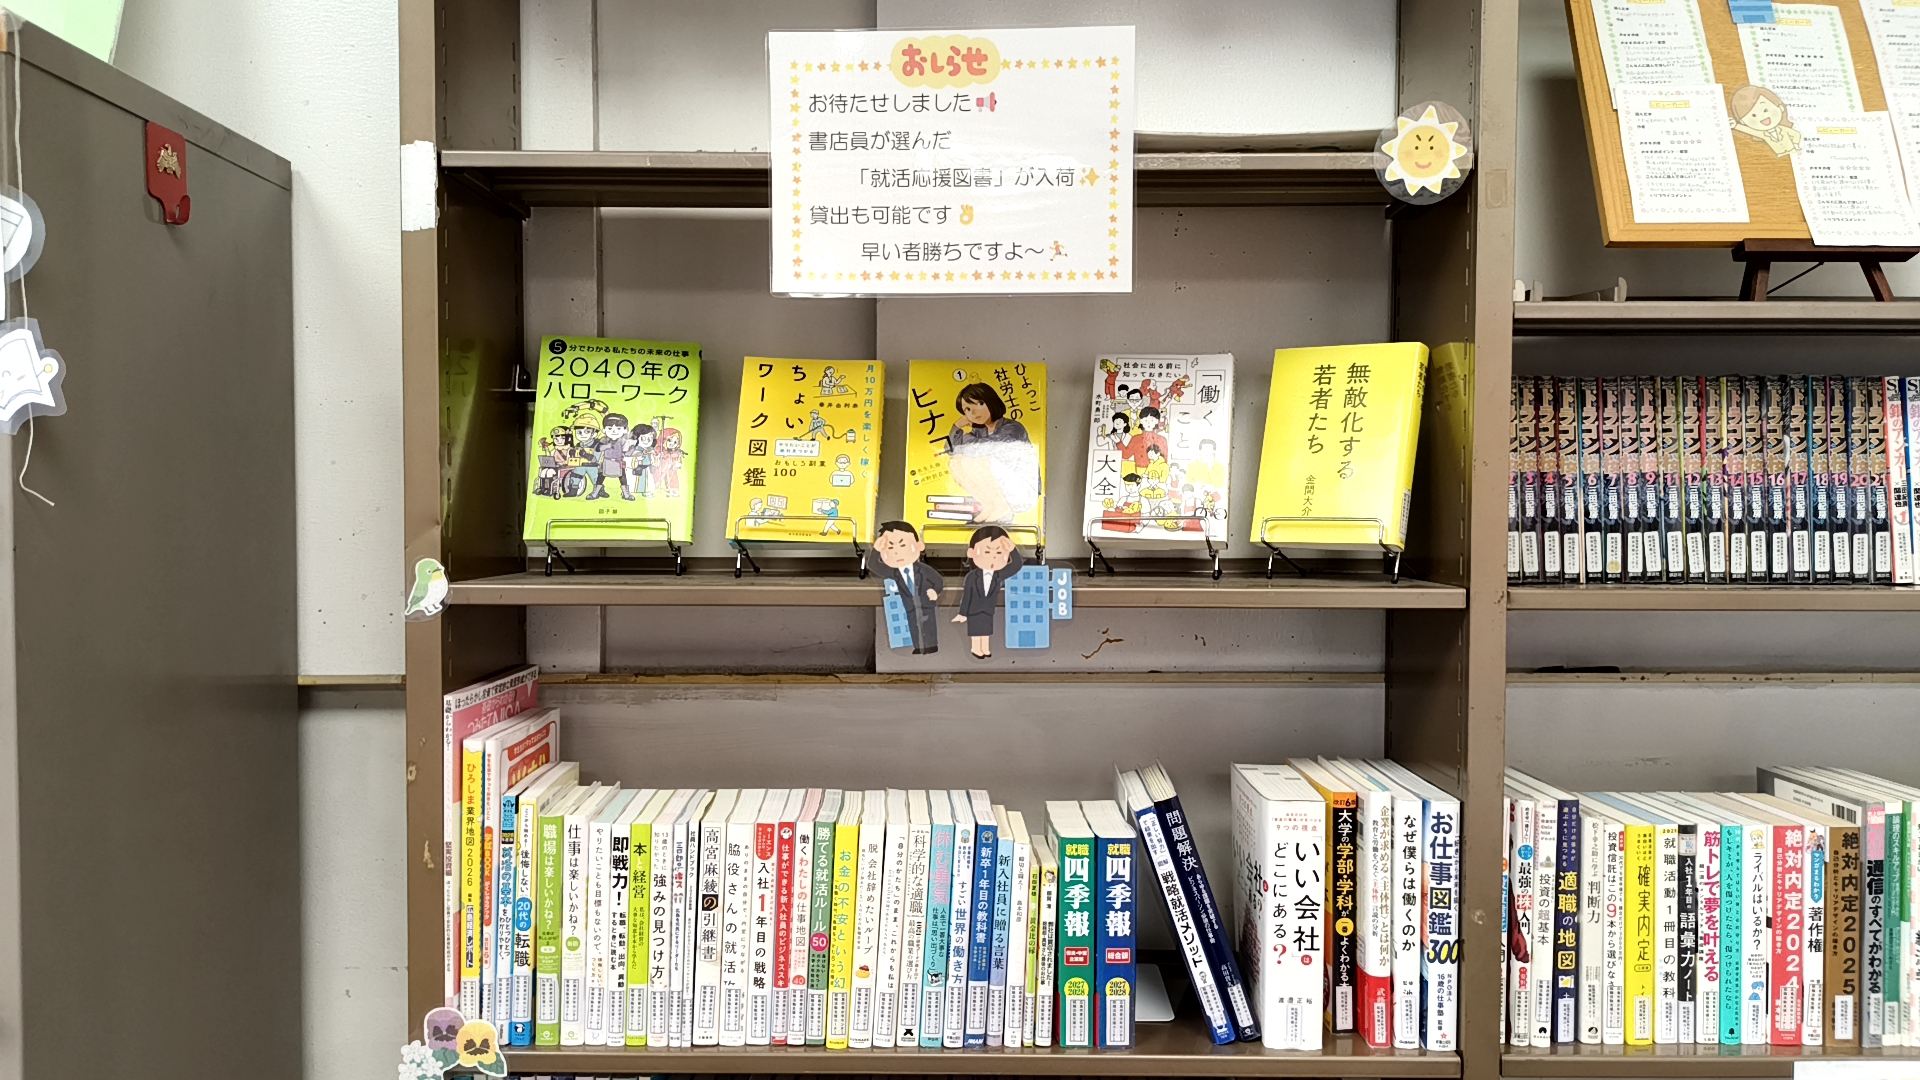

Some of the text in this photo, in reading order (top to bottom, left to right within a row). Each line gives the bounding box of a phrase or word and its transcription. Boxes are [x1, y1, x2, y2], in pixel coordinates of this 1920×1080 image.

[902, 44, 988, 76] おしらせ
[808, 93, 972, 113] お待たせしました
[808, 131, 951, 150] 書店員が選んだ
[858, 168, 1075, 188] 「就活応援図書」が入荷
[809, 206, 952, 225] 貸出も可能です
[543, 381, 688, 404] ハローワーク
[548, 356, 690, 381] 2040年の
[785, 364, 806, 429] ちょい
[994, 367, 1023, 420] 社労士の
[1123, 362, 1182, 370] 社会に出る前に
[742, 363, 773, 486] ワーク図鑑
[860, 364, 876, 478] 月10万円を楽しく稼ぐ
[1197, 374, 1222, 427] 「働く
[1307, 364, 1336, 454] 若者たち
[1337, 362, 1372, 479] 無敵化する
[773, 468, 797, 477] 100
[1889, 403, 1905, 479] 銀のアンカー
[1093, 454, 1118, 496] 大全
[1301, 475, 1316, 516] 金間大介
[1526, 472, 1534, 484] 3
[1545, 472, 1554, 483] 4
[1565, 474, 1573, 486] 5
[1588, 474, 1597, 486] 6
[1609, 474, 1617, 485] 7
[1627, 472, 1637, 485] 8
[1646, 472, 1656, 485] 9
[1664, 473, 1680, 486] 11
[1685, 473, 1701, 486] 12
[1707, 474, 1723, 486] 13
[1728, 474, 1744, 486] 14
[1748, 473, 1763, 484] 15
[1769, 474, 1785, 486] 16
[1791, 473, 1808, 485] 17
[1813, 474, 1829, 486] 18
[1832, 473, 1848, 486] 19
[1850, 474, 1869, 486] 20
[1871, 474, 1887, 486] 21
[1899, 511, 1907, 523] 1
[1058, 572, 1068, 616] JOB
[465, 763, 476, 887] ひろしま業界地図2026
[1065, 844, 1090, 856] 就職
[1107, 844, 1131, 856] 就職
[1165, 809, 1199, 872] 問題解決
[543, 824, 557, 930] 職場は楽しいかね？
[568, 824, 582, 935] 仕事は楽しいかね？
[612, 837, 629, 906] 即戦力！
[632, 842, 647, 899] 本と経営
[701, 829, 719, 960] 高宮麻綾の引継書
[795, 834, 810, 947] 働くわたしの仕事地図
[812, 827, 831, 947] 勝てる就活ルール 50
[909, 835, 927, 914] 科学的な適職
[932, 830, 952, 904] 休む勇気
[975, 847, 992, 944] 新卒1年目の教科書
[1064, 856, 1090, 937] 四季報
[1105, 856, 1132, 937] 四季報
[1402, 815, 1418, 951] なぜ僕らは働くのか
[1427, 811, 1459, 965] お仕事図鑑 300
[515, 850, 530, 967] 後悔しない 20代の 転職
[651, 873, 667, 979] 強みの見つけ方
[753, 862, 770, 989] 入社1年目の戦略
[777, 845, 790, 987] 仕事ができる新入社員のビジネススキ
[834, 850, 851, 988] お金の不安という幻
[952, 881, 968, 984] すごい世界の働き方
[992, 854, 1011, 970] 新入社員に贈る言葉
[1160, 870, 1203, 968] 戦略就活メソッド
[1273, 842, 1289, 965] どこにある？
[1537, 874, 1551, 945] 投資の超基本
[1557, 871, 1577, 970] 適職の地図
[1587, 880, 1601, 924] 判断力
[1606, 832, 1618, 987] 投資信託はこの9本から選びなさ
[1637, 864, 1651, 962] 確実内定
[1663, 838, 1676, 998] 就職活動1冊目の教科
[1680, 858, 1696, 1001] 入社1年目の 語彙力ノート
[1703, 831, 1720, 982] 筋トレで夢を叶える
[1752, 852, 1764, 950] ライバルはいるか？
[1784, 829, 1803, 989] 絶対内定2024
[1808, 906, 1823, 953] 著作権
[1841, 831, 1859, 995] 絶対内定2025
[1866, 859, 1884, 994] 通信のすべてがわかる
[1107, 952, 1129, 960] 総合版
